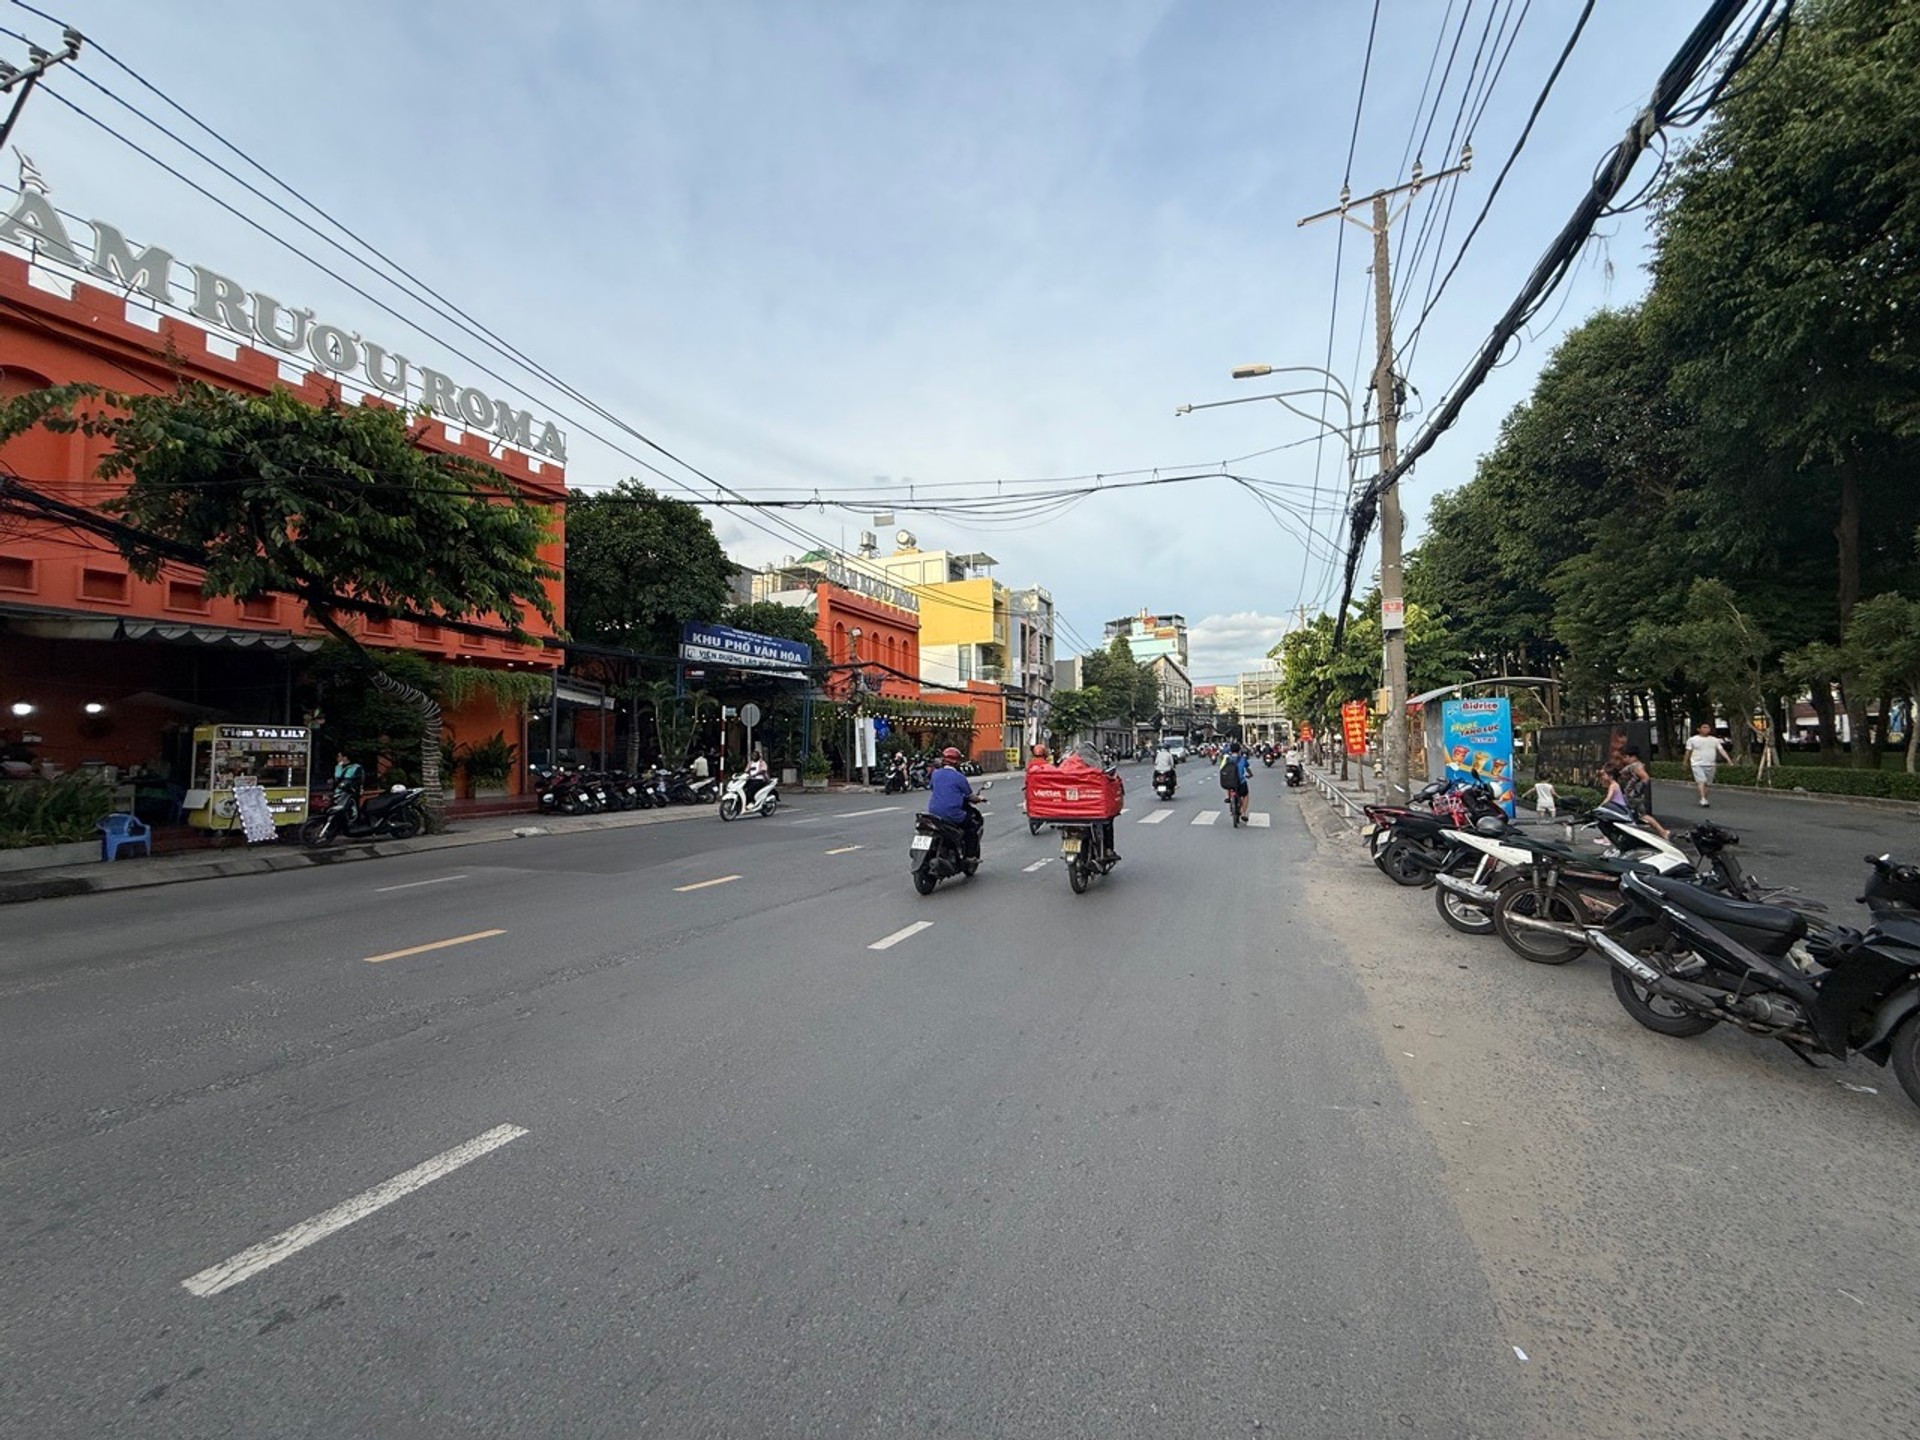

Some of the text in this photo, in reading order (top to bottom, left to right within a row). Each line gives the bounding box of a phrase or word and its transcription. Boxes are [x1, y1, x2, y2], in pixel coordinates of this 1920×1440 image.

[188, 264, 411, 395] RƯỢU
[420, 365, 568, 462] ROMA
[692, 632, 721, 647] KHU
[724, 638, 751, 652] PHỐ
[1462, 701, 1499, 710] Bidrico
[222, 728, 306, 738] Tiệm Trà LILY
